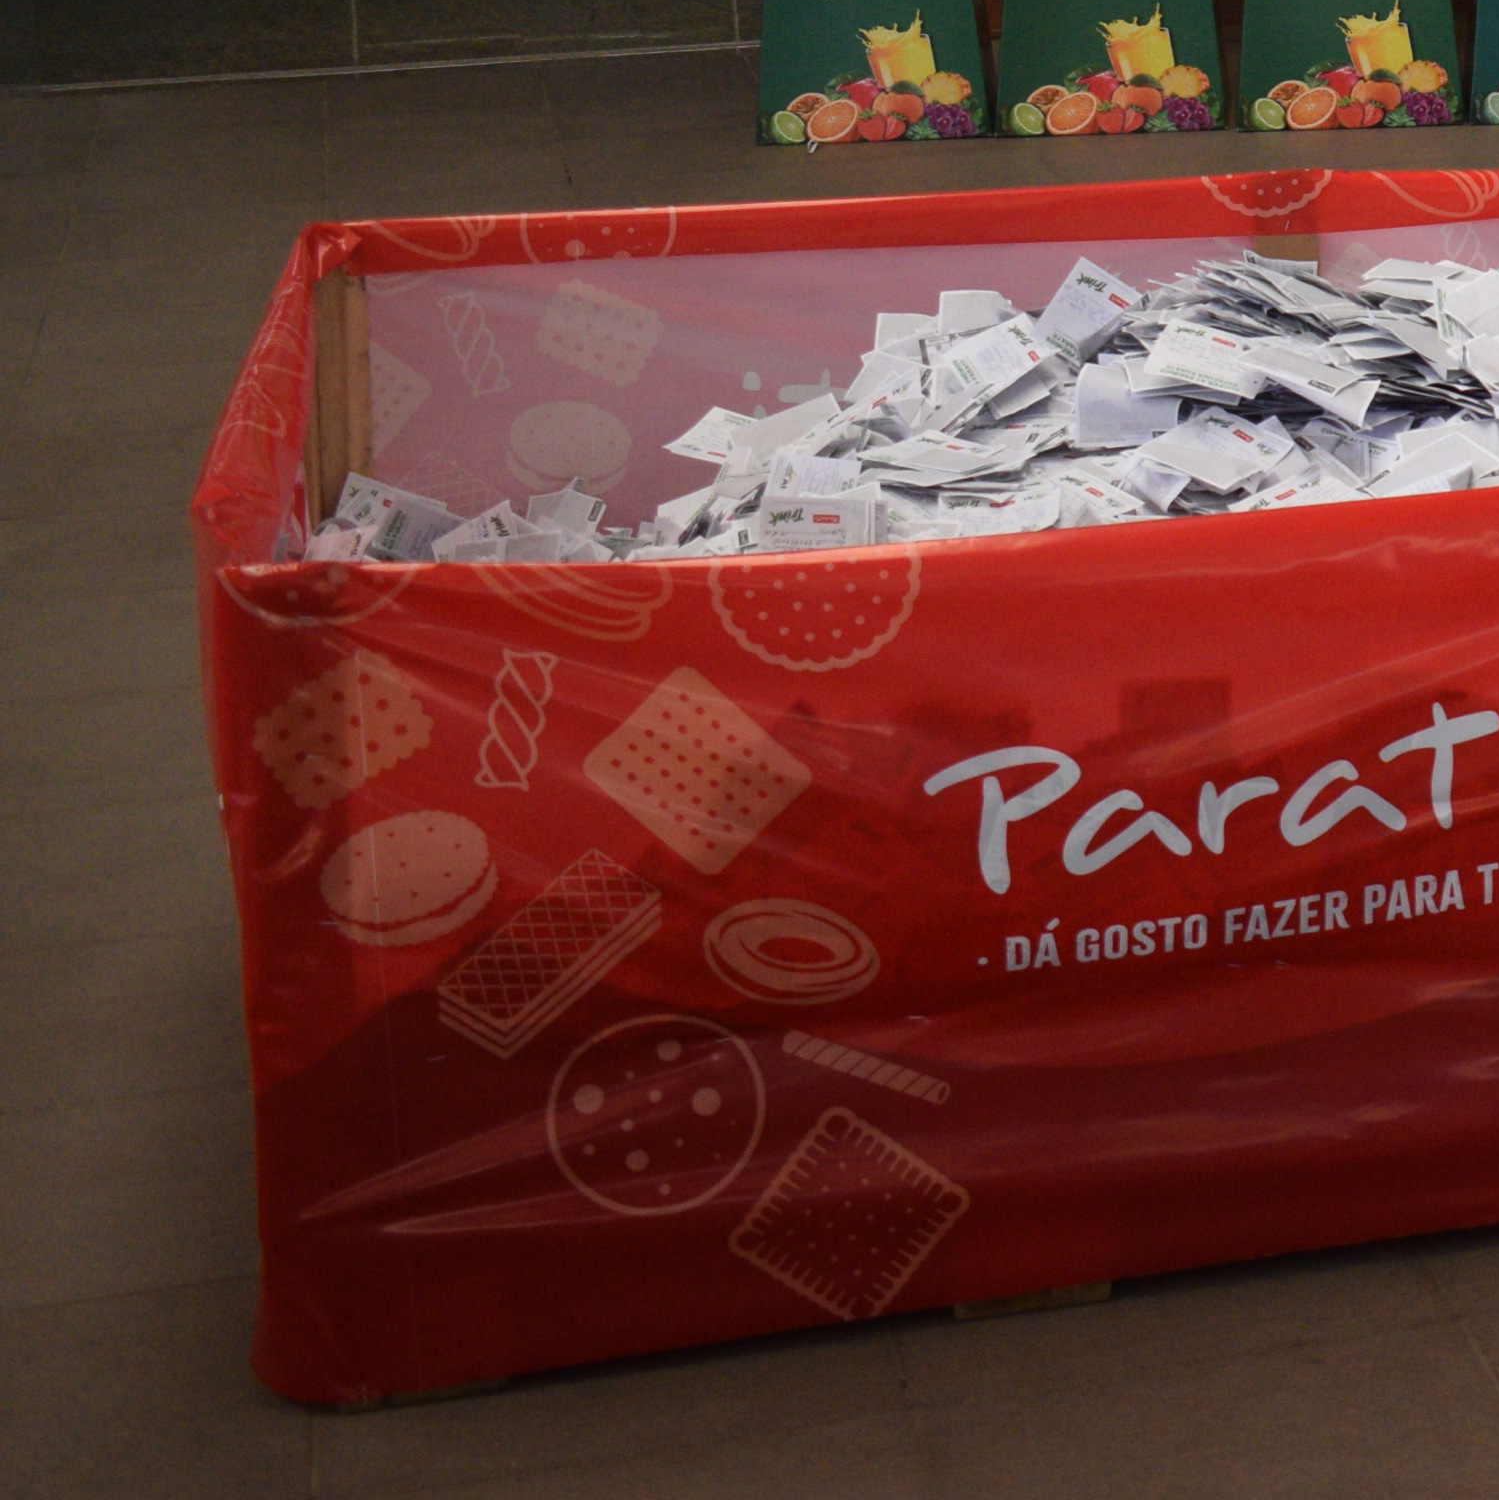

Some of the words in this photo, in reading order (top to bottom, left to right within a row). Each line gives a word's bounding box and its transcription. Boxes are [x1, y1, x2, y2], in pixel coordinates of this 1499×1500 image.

[1006, 918, 1062, 972] DÁ
[1076, 915, 1208, 962] GOSTO
[1224, 891, 1350, 944] FAZER
[1364, 870, 1465, 925] PARA
